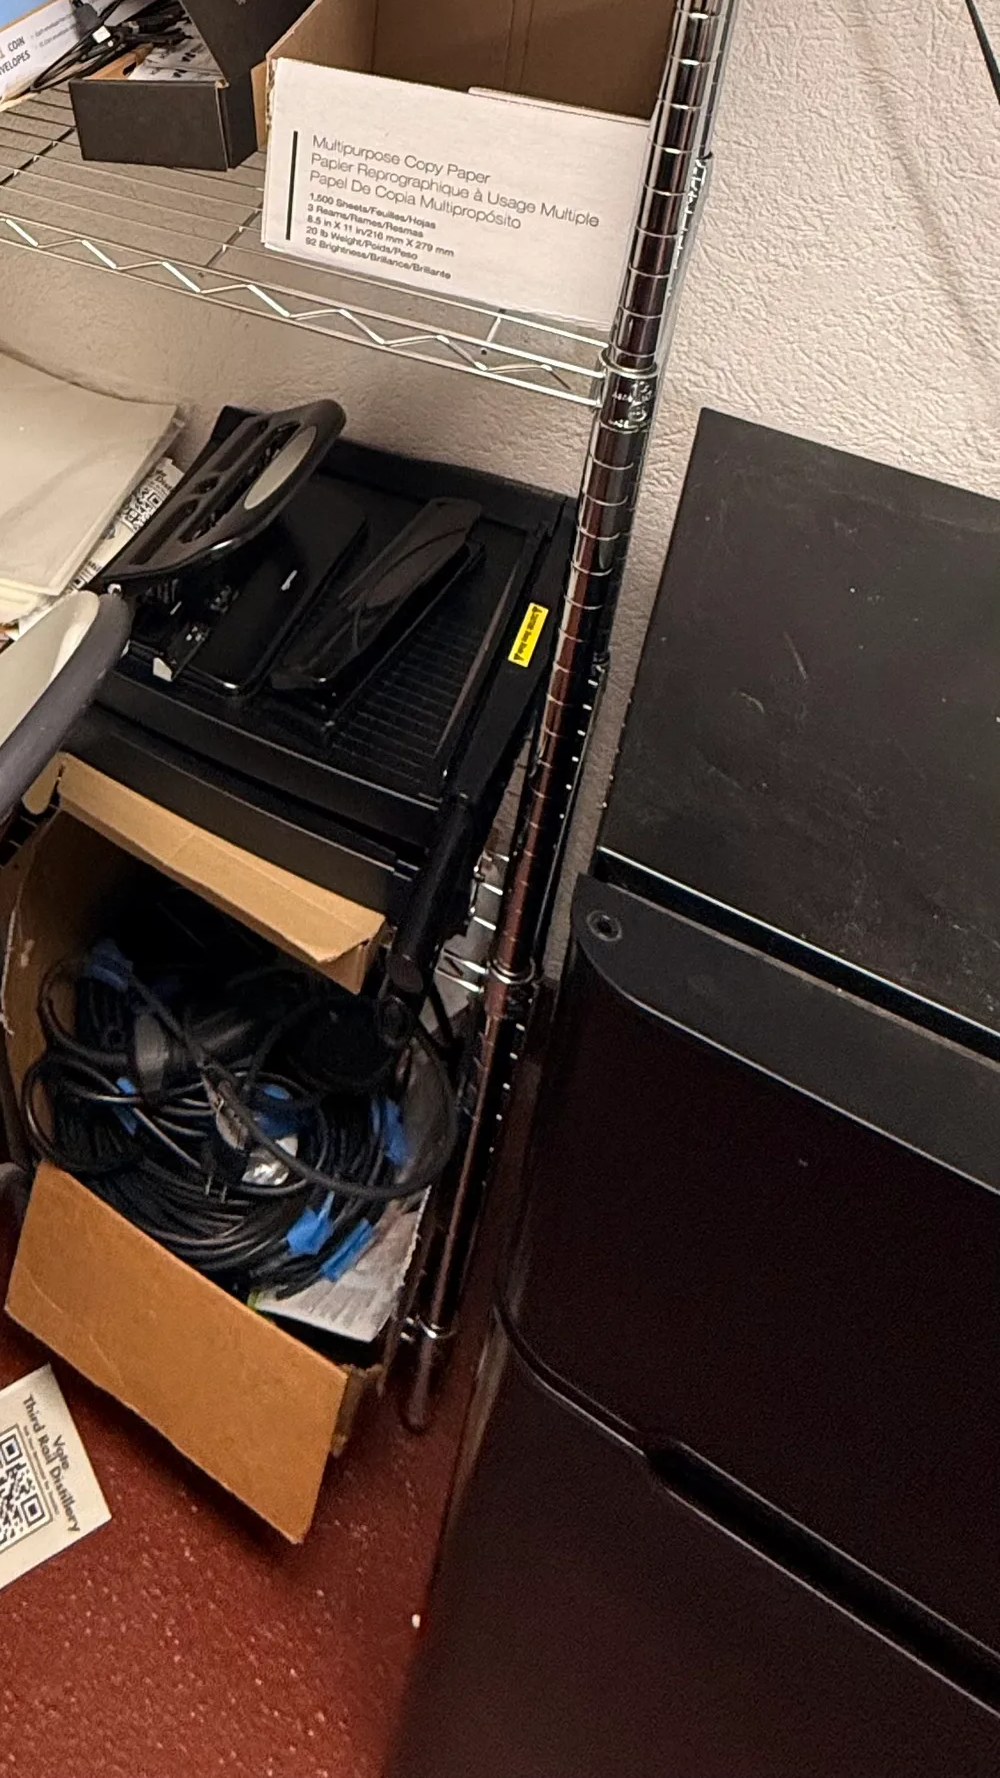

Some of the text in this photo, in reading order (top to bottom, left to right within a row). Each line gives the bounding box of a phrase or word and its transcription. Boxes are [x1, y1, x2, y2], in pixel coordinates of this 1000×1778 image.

[7, 35, 26, 53] COIN
[312, 134, 491, 185] Multipurpose Copy Paper
[310, 170, 522, 230] Papel De Copia Multipropósito
[311, 152, 600, 228] Papier Reprographique à Usage Multiple
[306, 214, 322, 226] 8.5
[323, 218, 332, 228] in
[333, 221, 341, 231] X
[344, 224, 353, 234] 11
[385, 234, 404, 245] mm
[406, 238, 414, 248] X
[414, 240, 434, 253] 279
[435, 247, 455, 258] mm
[307, 203, 424, 239] 3 Reams/Rames/Resmas
[336, 199, 437, 230] Sheets/Feuilles/Hojas
[305, 225, 419, 261] 20 lb Weight/Poids/Peso
[305, 236, 452, 280] 92 Brightness/Brillance/Brillante
[22, 1393, 46, 1434] Third
[37, 1433, 59, 1466] Rail
[49, 1465, 81, 1533] Distillery
[53, 1434, 70, 1471] Vote
